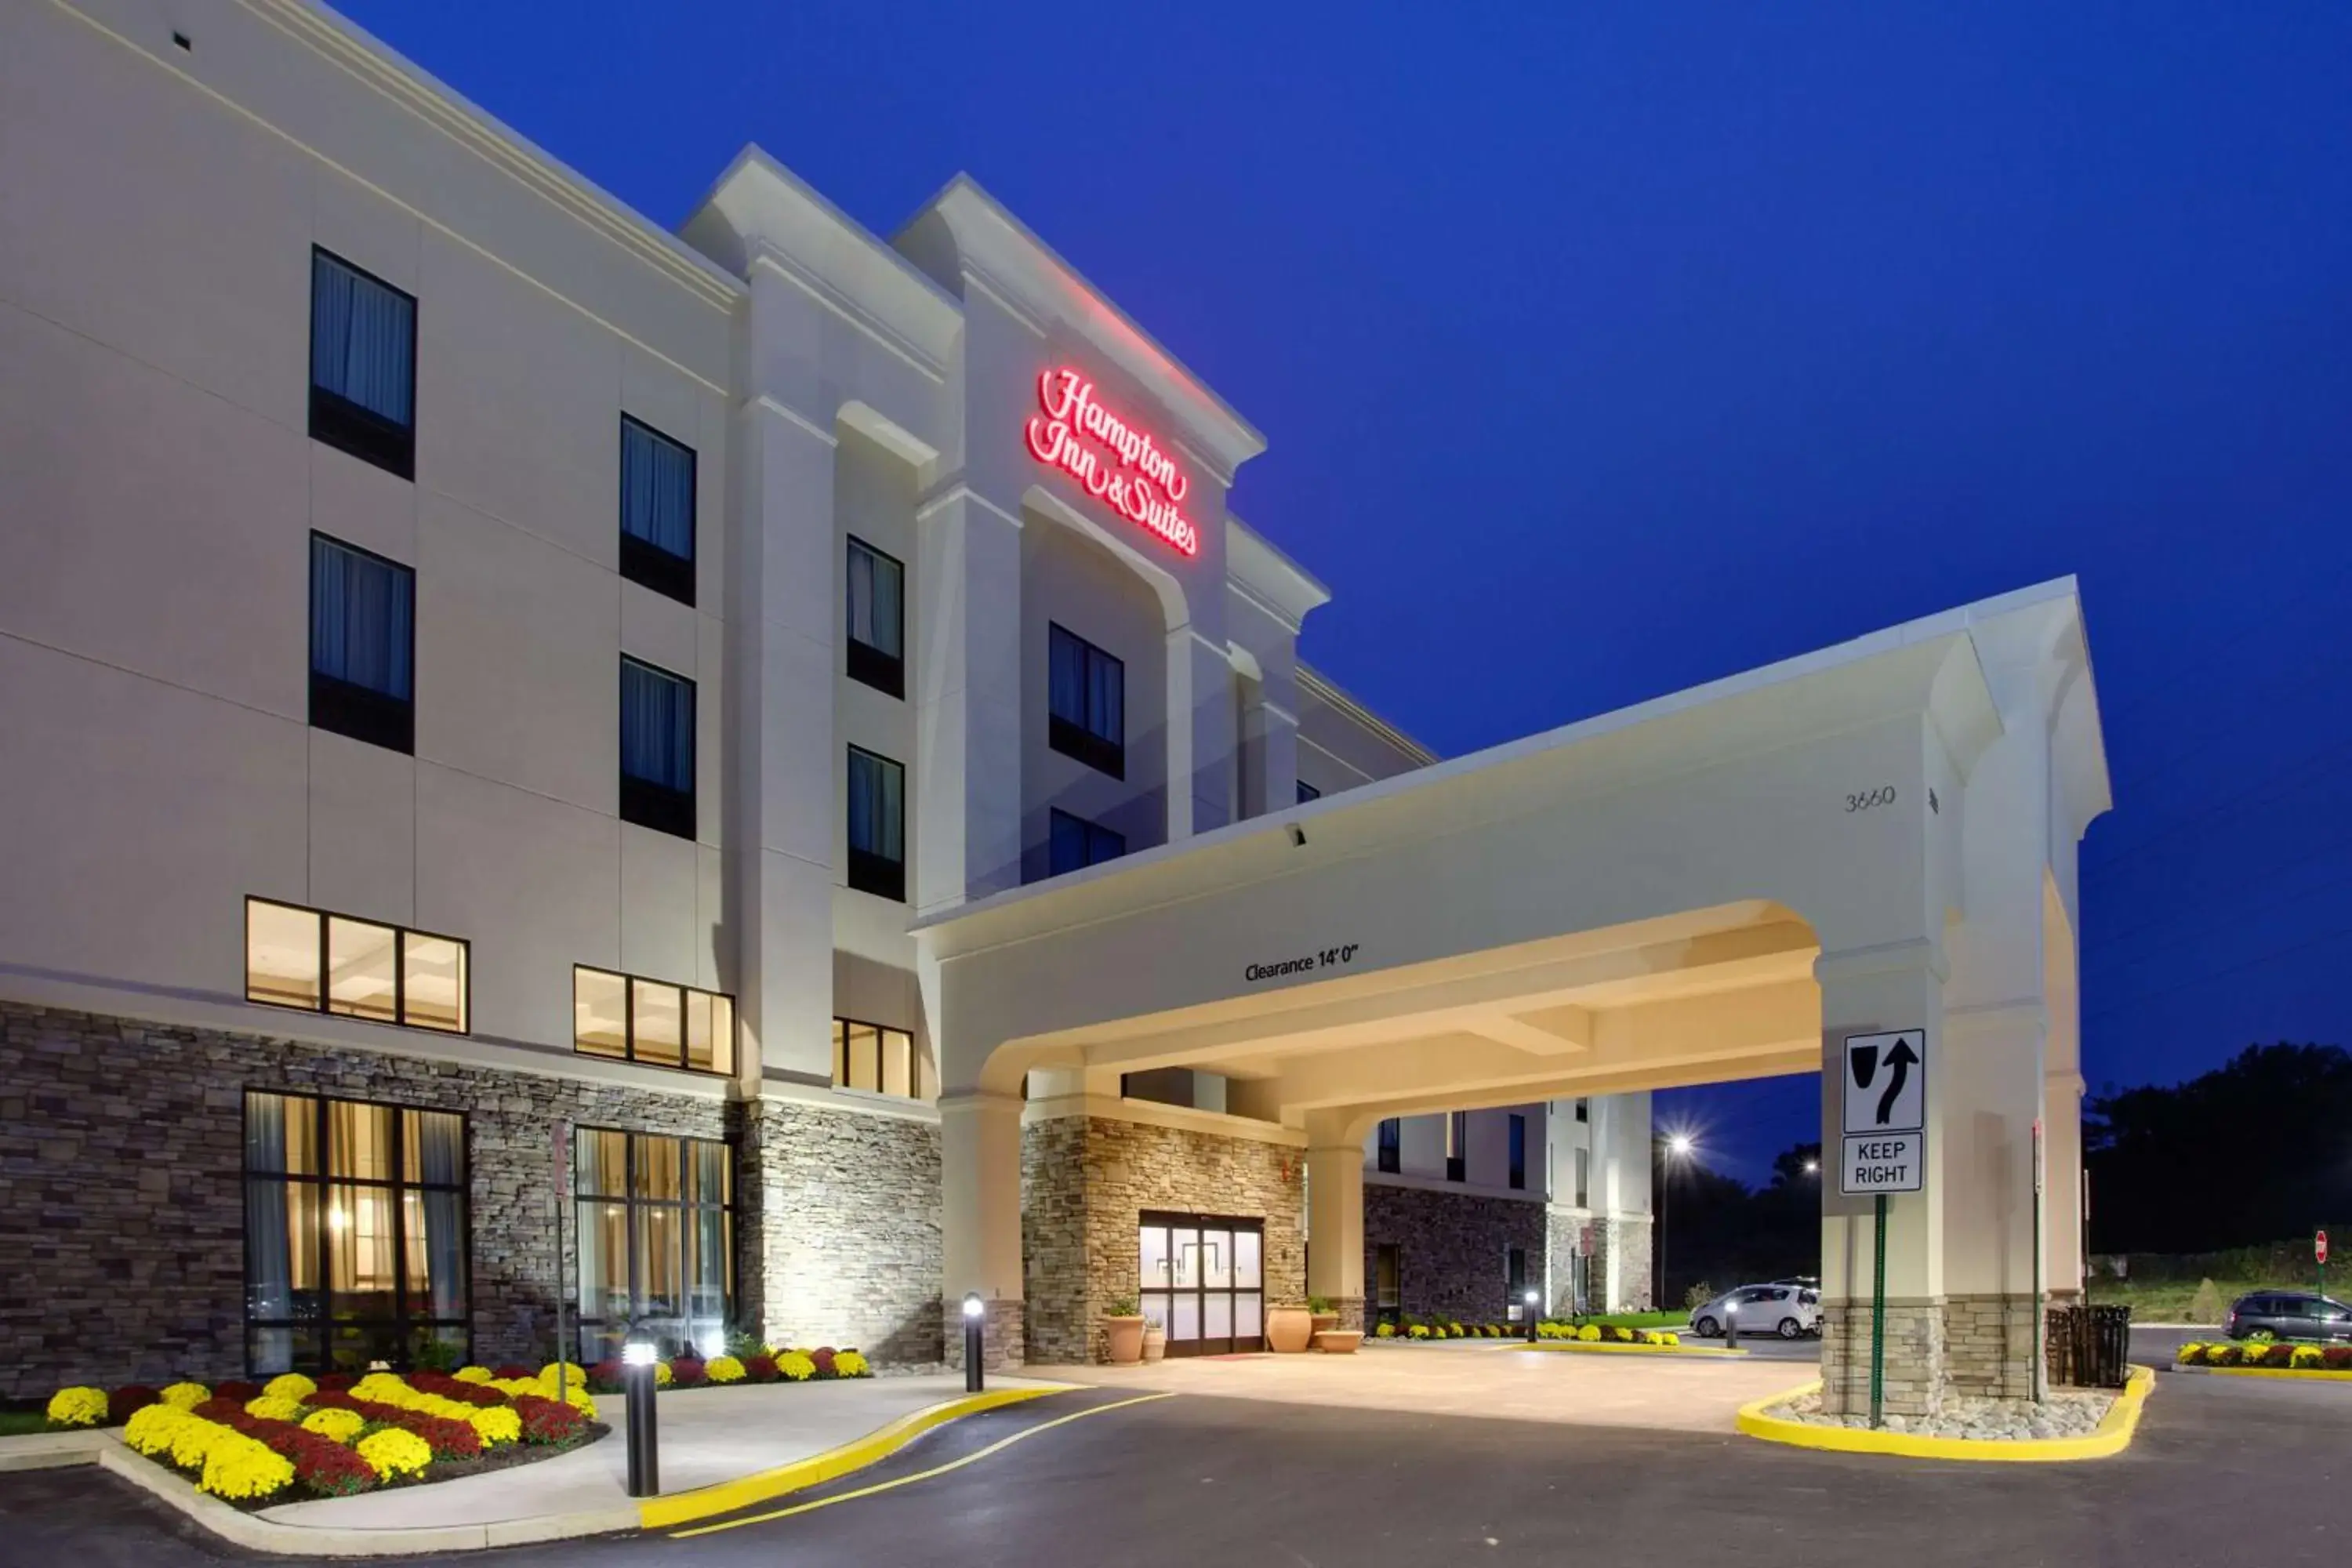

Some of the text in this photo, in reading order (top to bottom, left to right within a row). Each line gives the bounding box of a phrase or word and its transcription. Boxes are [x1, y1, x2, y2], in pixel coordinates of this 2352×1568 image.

[1039, 370, 1186, 500] Hampton
[1025, 418, 1196, 555] Inn & Suites
[1845, 786, 1896, 812] 3660
[1246, 956, 1314, 981] Clearance
[1858, 1142, 1906, 1160] KEEP
[1856, 1166, 1907, 1184] RIGHT
